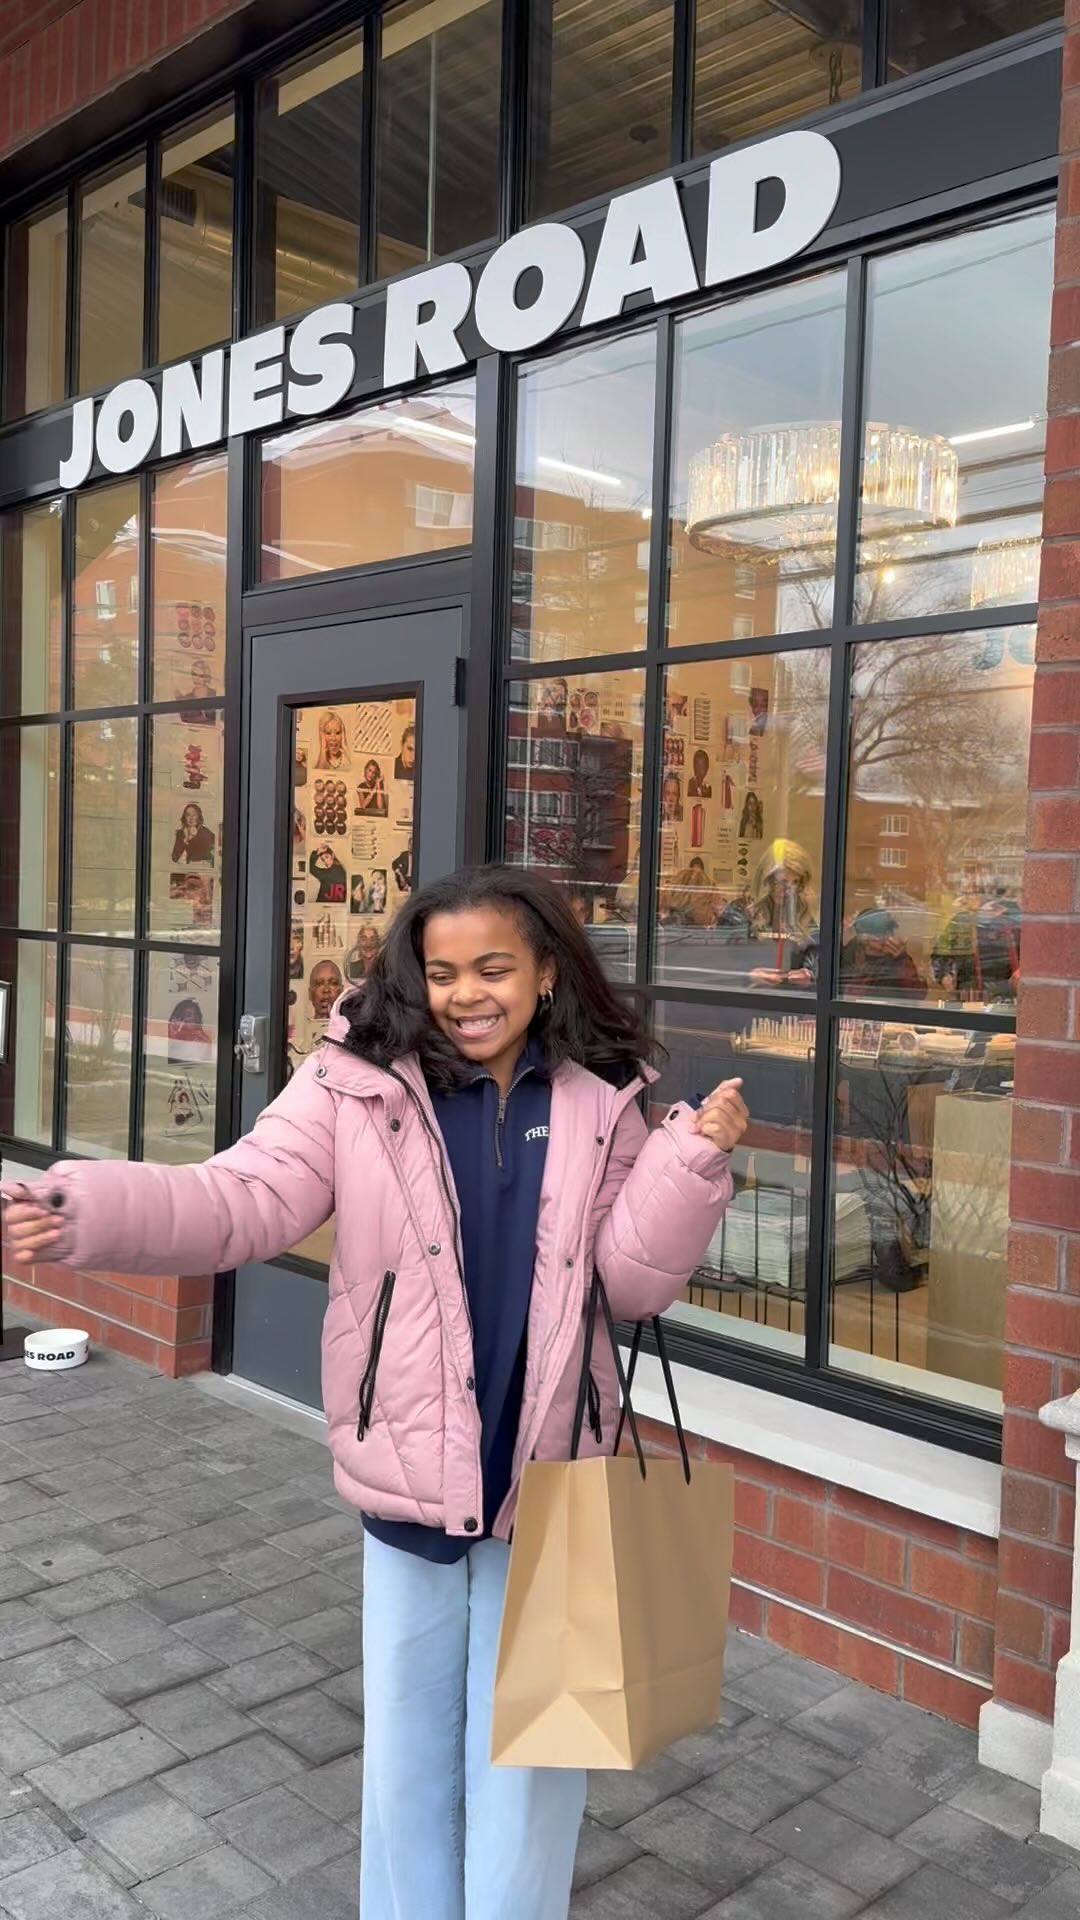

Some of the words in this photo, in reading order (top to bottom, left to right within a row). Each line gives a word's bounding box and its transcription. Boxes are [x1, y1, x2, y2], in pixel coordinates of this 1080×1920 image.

[59, 304, 355, 489] JONES
[384, 130, 841, 389] ROAD
[325, 884, 345, 900] JR
[524, 1126, 549, 1142] THE
[37, 1351, 75, 1361] ROAD
